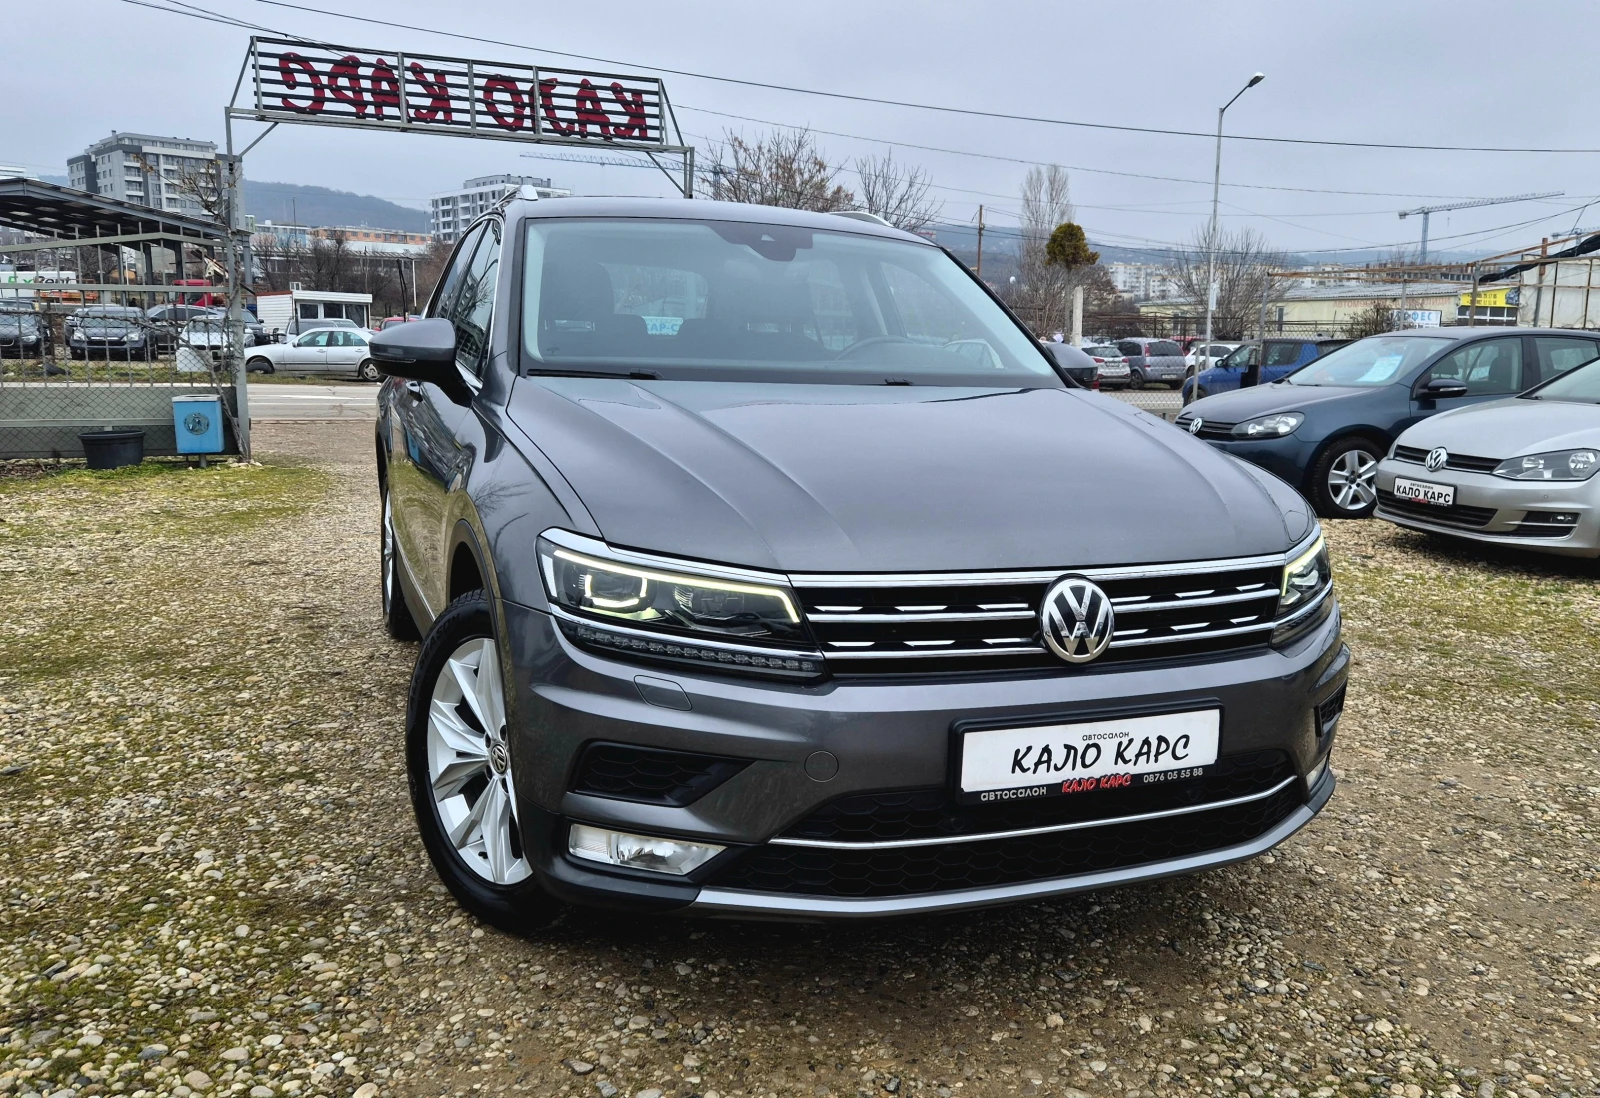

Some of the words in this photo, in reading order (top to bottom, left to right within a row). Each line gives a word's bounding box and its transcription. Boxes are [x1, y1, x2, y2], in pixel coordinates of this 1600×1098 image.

[1396, 485, 1420, 497] КАЛО
[1424, 490, 1450, 503] КАРС
[1081, 731, 1130, 742] автосалон
[1011, 742, 1102, 775] КАЛО
[1113, 734, 1191, 767] КАРС
[980, 786, 1047, 802] автосалон
[1061, 777, 1097, 794] КАЛО
[1099, 772, 1132, 789] КАРС
[1143, 772, 1165, 784] 0876
[1167, 771, 1178, 781] 05
[1180, 769, 1191, 779] 55
[1193, 767, 1204, 777] 88
